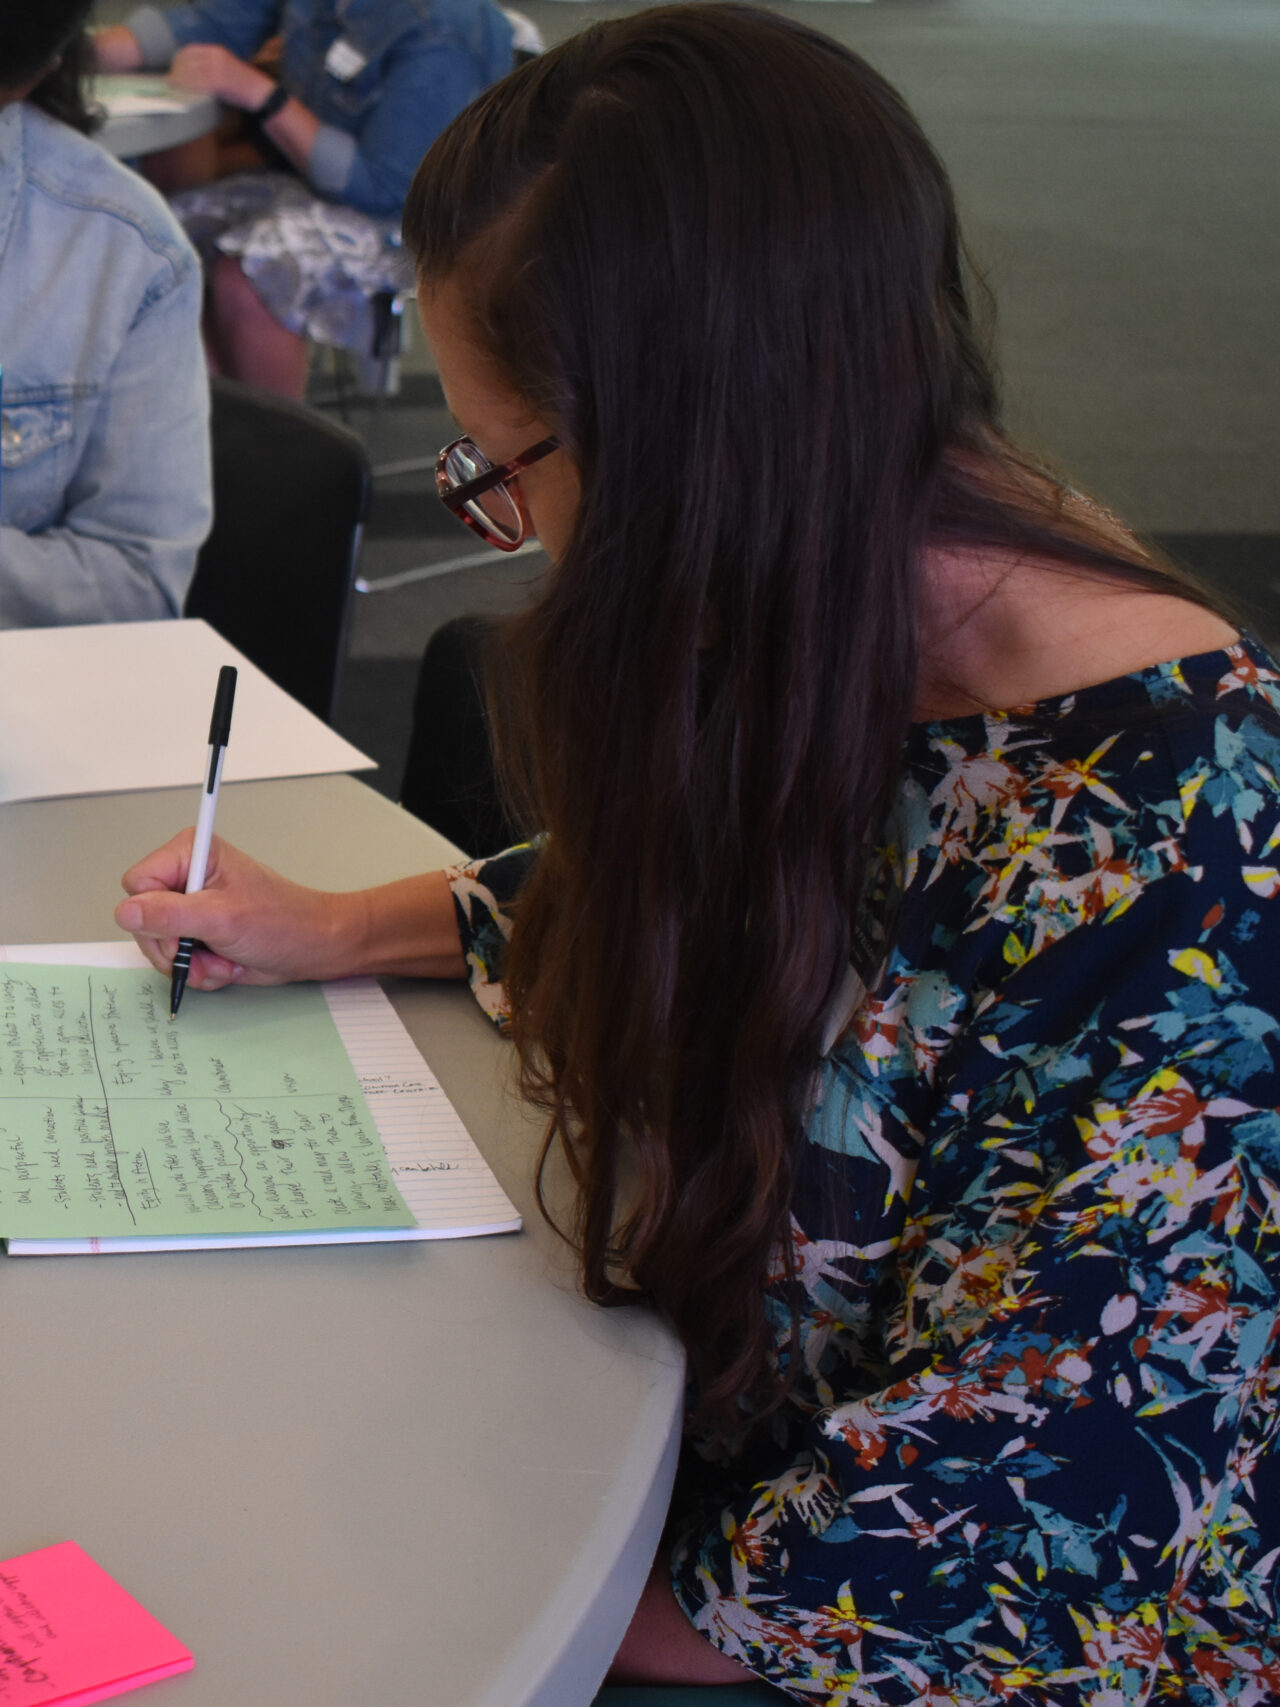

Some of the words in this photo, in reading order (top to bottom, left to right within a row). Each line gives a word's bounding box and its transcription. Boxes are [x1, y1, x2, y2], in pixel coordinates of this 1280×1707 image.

[49, 986, 61, 996] to
[136, 984, 152, 996] be
[139, 999, 159, 1024] should
[29, 1014, 54, 1062] opportunities
[58, 1024, 78, 1043] gain
[148, 1024, 160, 1034] we
[148, 1039, 164, 1060] believe
[165, 1031, 179, 1050] access
[168, 1053, 180, 1061] to
[113, 1058, 140, 1085] Equity
[170, 1062, 188, 1075] able
[294, 1110, 316, 1132] their
[318, 1113, 333, 1124] to
[341, 1112, 362, 1126] from
[232, 1103, 269, 1156] opportunity
[326, 1126, 342, 1145] them
[351, 1128, 373, 1148] learn
[304, 1138, 320, 1151] for
[7, 1136, 40, 1180] purposeful
[42, 1149, 61, 1168] need
[76, 1152, 98, 1168] need
[130, 1152, 146, 1174] Action
[256, 1160, 268, 1171] an
[276, 1155, 296, 1175] their
[314, 1151, 329, 1167] map
[336, 1151, 356, 1174] allow
[313, 1168, 336, 1185] road
[12, 1189, 31, 1204] and
[137, 1188, 159, 1210] Equity
[300, 1208, 316, 1218] to
